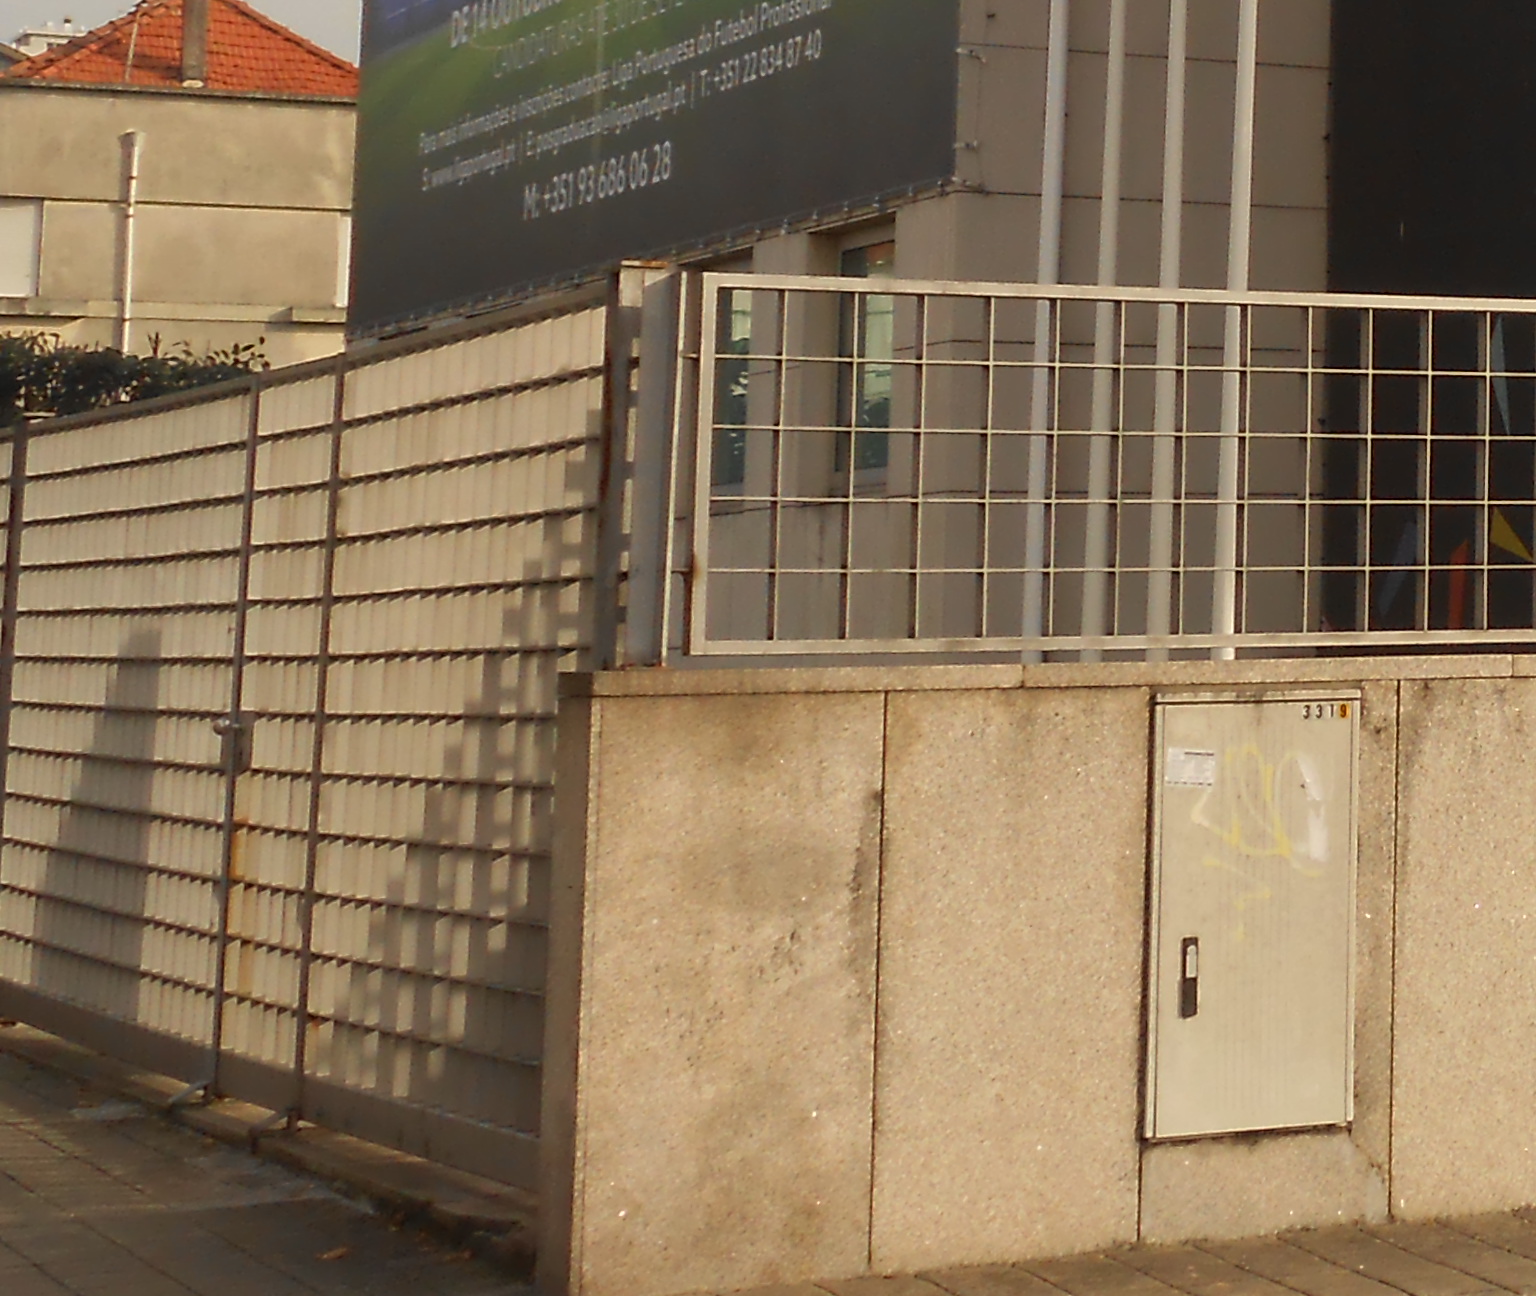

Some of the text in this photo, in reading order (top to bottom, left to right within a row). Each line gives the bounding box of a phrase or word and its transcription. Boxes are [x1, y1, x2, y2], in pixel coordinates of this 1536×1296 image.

[453, 6, 471, 48] DE
[697, 23, 713, 56] do
[715, 3, 760, 48] Futebol
[713, 58, 741, 92] +351
[743, 51, 759, 83] 22
[760, 42, 784, 78] 834
[785, 35, 803, 69] 87
[805, 27, 824, 62] 40
[543, 172, 575, 214] +351
[577, 165, 596, 206] 93
[597, 155, 628, 200] 686
[629, 147, 651, 192] 06
[652, 140, 674, 185] 28
